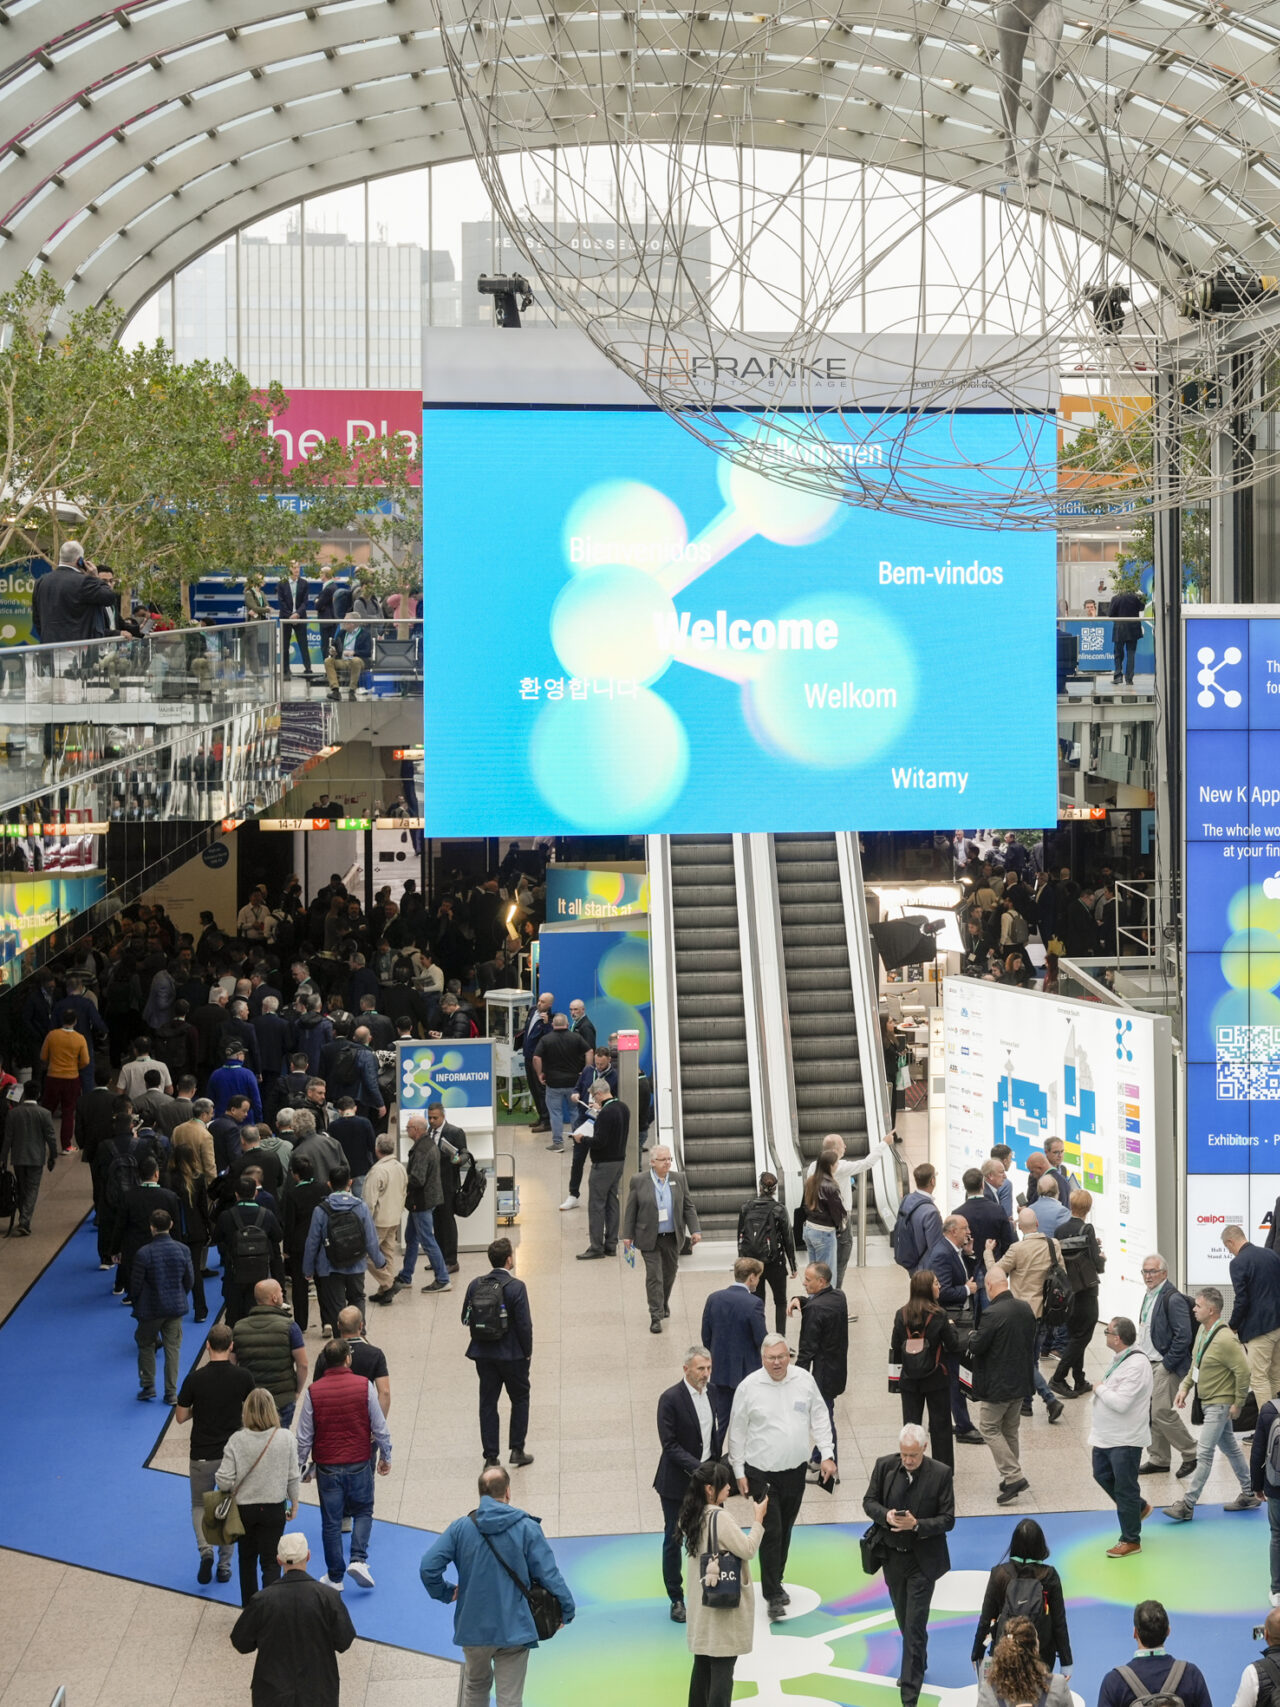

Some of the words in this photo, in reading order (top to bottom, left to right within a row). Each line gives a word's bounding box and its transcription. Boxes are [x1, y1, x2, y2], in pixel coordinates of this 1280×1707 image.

[692, 357, 847, 380] FRANKE
[767, 380, 847, 388] SIGNAGE
[570, 535, 712, 563] Bienvenidos
[878, 560, 1004, 585] Bem-vindos
[654, 610, 838, 650] Welcome
[518, 677, 641, 700] 환영합니다
[804, 682, 897, 709] Welkom
[892, 766, 968, 794] Witamy
[1199, 786, 1232, 803] New
[1237, 786, 1247, 803] K
[1251, 786, 1280, 807] App
[1063, 809, 1083, 818] 7a-1
[278, 819, 303, 829] 14-17
[1202, 823, 1223, 837] The
[1225, 823, 1261, 837] whole
[1223, 845, 1235, 857] at
[1237, 847, 1264, 860] your
[558, 898, 566, 914] It
[568, 899, 582, 915] all
[585, 901, 618, 917] starts
[620, 904, 633, 915] at
[435, 1072, 489, 1082] INFORMATION
[1208, 1134, 1259, 1146] Exhibitors
